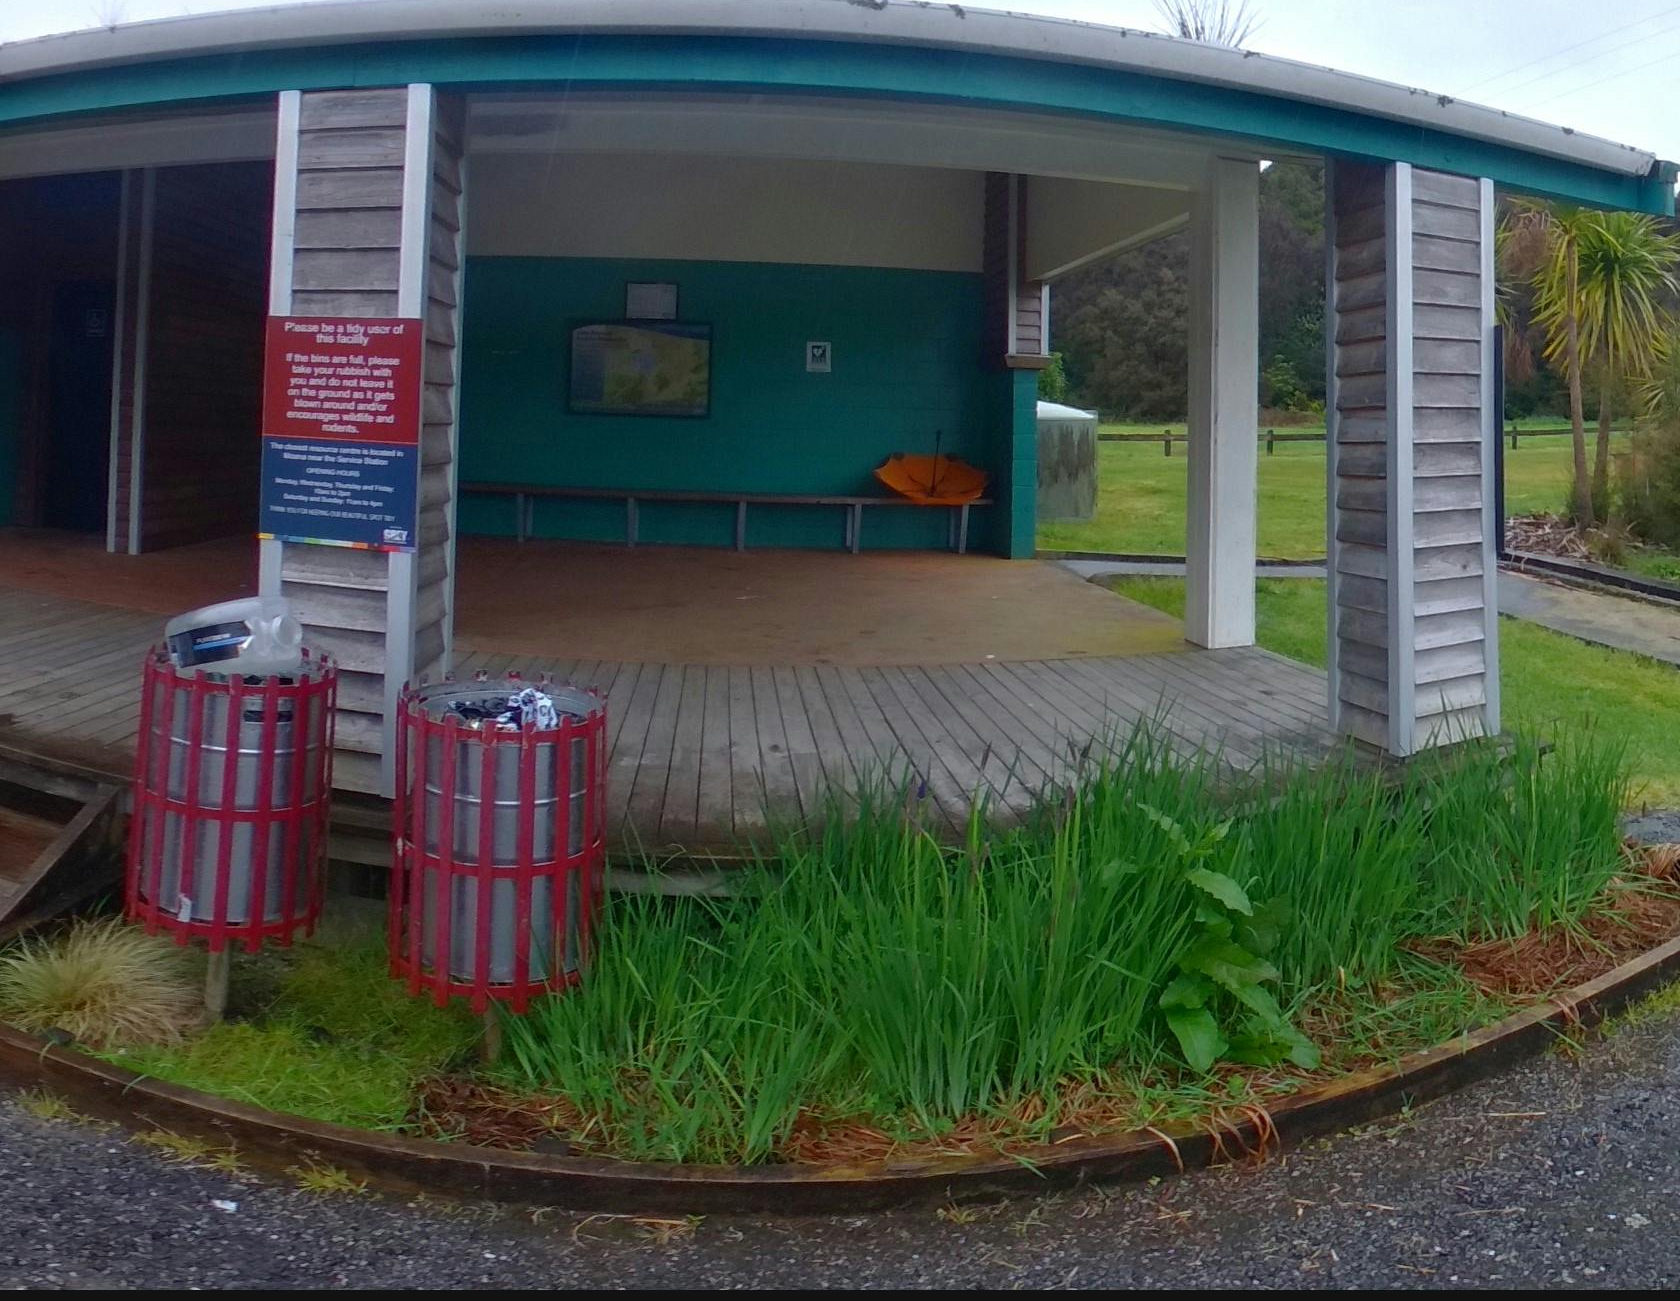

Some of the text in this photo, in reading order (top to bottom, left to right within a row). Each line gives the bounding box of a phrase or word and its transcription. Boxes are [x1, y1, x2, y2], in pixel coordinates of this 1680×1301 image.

[285, 322, 404, 335] Please be a tidy user of
[316, 334, 369, 346] this facility
[286, 353, 292, 361] If
[294, 354, 308, 362] the
[311, 355, 330, 363] bins
[349, 355, 365, 365] full,
[368, 357, 400, 366] please
[292, 365, 392, 377] take your rubbish with
[290, 378, 306, 386] you
[309, 378, 326, 386] and
[328, 378, 340, 386] do
[360, 379, 385, 387] leave
[387, 380, 393, 388] it
[302, 388, 315, 396] the
[318, 389, 350, 398] ground
[367, 391, 372, 399] it
[374, 392, 394, 401] gets
[294, 399, 387, 411] blown around and/or
[286, 410, 394, 423] encourages wildlife and
[322, 423, 359, 433] rodents.
[370, 448, 395, 456] located
[324, 454, 335, 462] the
[336, 456, 362, 464] Service
[364, 457, 388, 465] Station
[336, 469, 360, 477] HOURS
